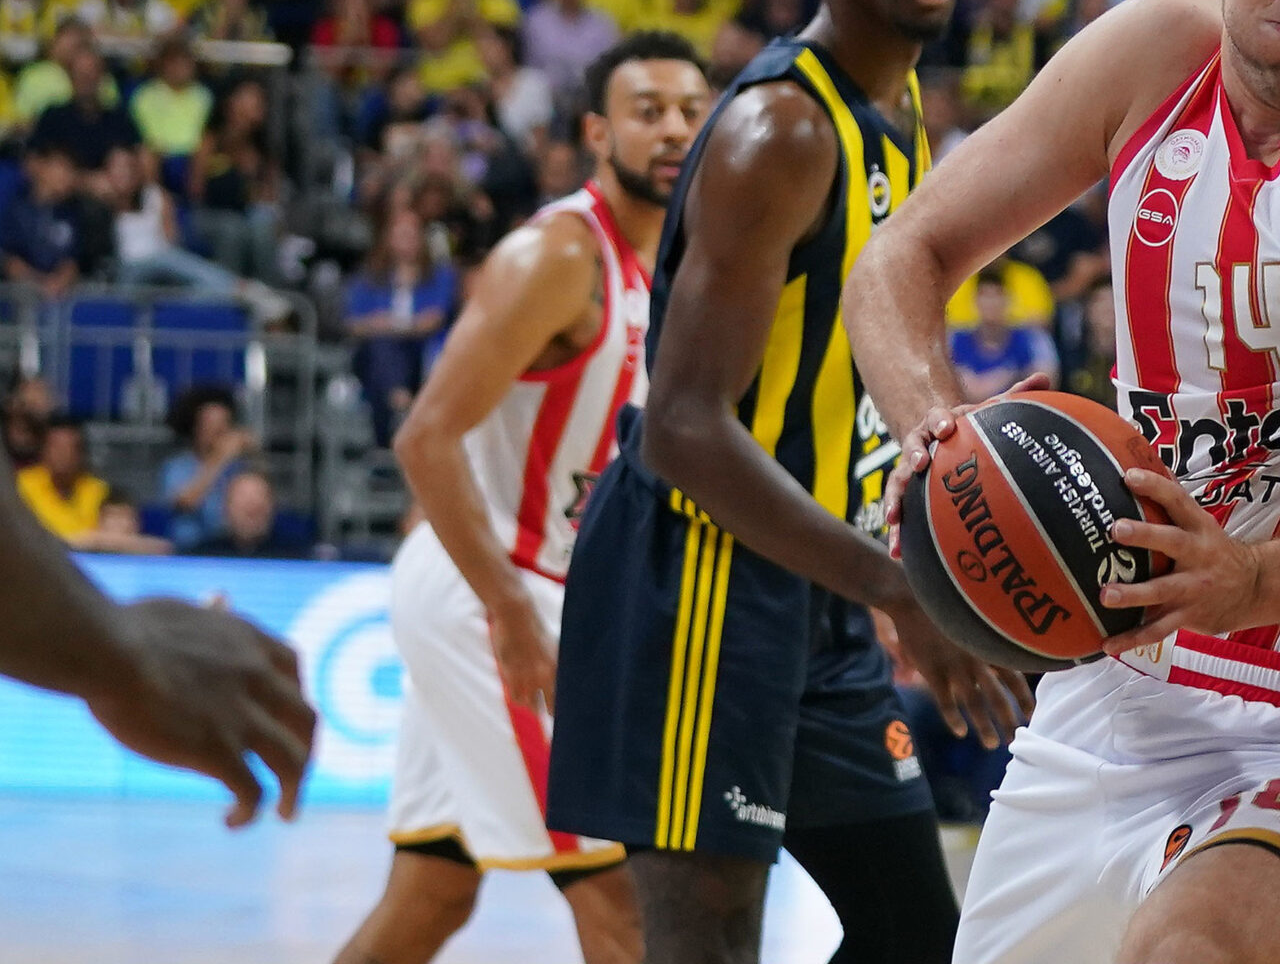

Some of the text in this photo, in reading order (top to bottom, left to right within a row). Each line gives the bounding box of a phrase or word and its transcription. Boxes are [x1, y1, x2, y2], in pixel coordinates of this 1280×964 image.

[1139, 208, 1174, 226] GSA
[942, 449, 1072, 635] SPALDING
[1001, 421, 1104, 554] TURKISH AIRLINES
[1044, 433, 1116, 544] uroLeague
